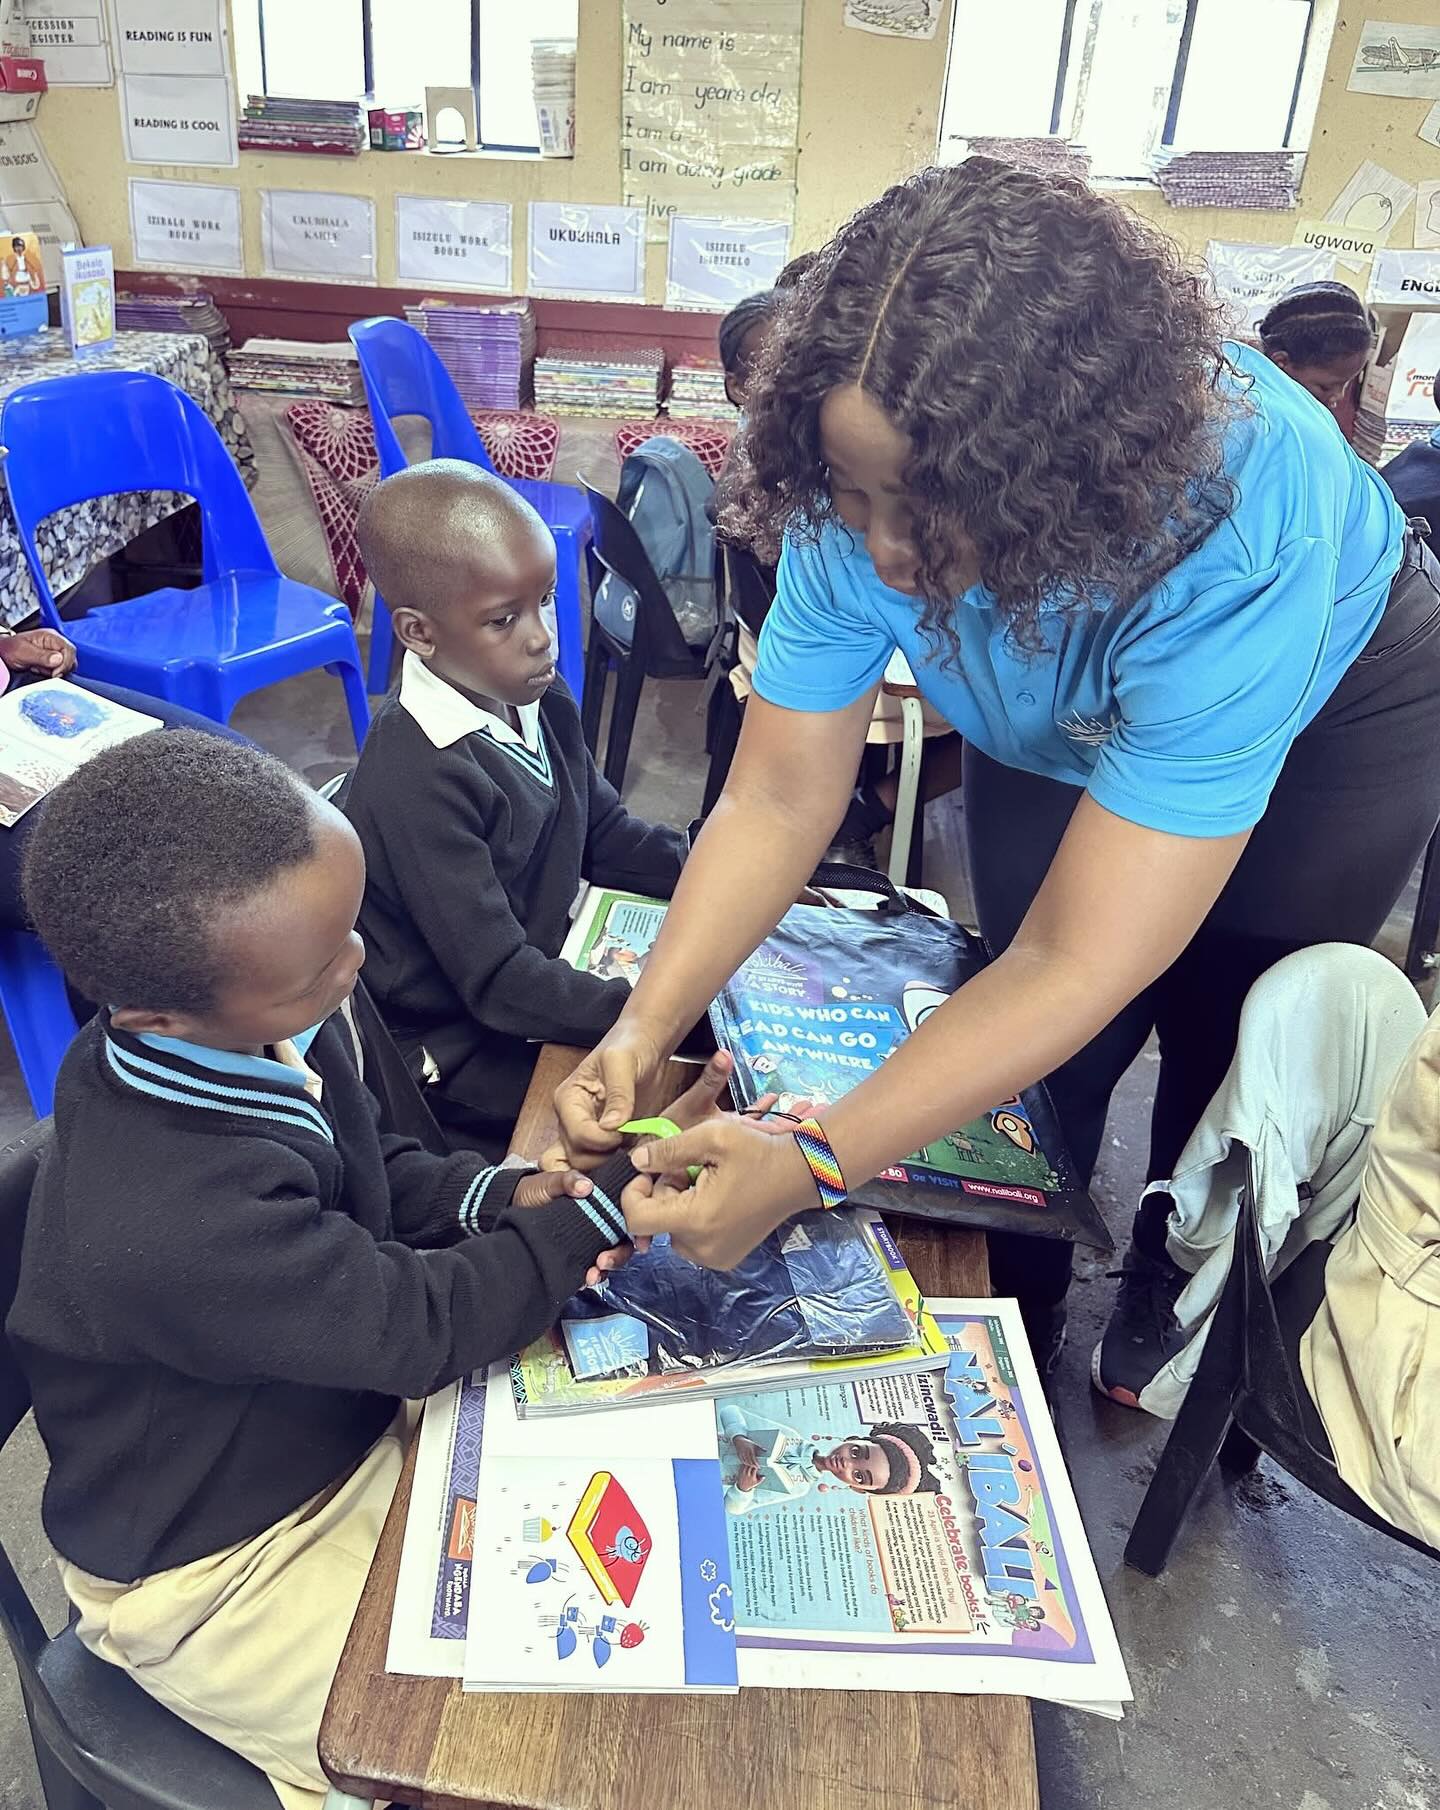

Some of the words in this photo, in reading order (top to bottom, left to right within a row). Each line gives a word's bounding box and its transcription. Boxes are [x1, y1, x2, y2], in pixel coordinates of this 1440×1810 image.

[26, 20, 74, 30] CESSION
[30, 34, 74, 44] EGISTER
[125, 30, 175, 41] READING
[178, 32, 186, 42] IS
[190, 32, 212, 42] FUN
[629, 23, 652, 57] My
[663, 35, 712, 50] name
[719, 32, 735, 51] is
[624, 65, 637, 92] I
[640, 80, 671, 95] am
[695, 86, 745, 109] years
[750, 82, 781, 104] old
[134, 118, 177, 129] READING
[181, 120, 189, 130] IS
[192, 121, 220, 131] COOL
[623, 116, 634, 138] I
[637, 127, 662, 140] am
[670, 129, 682, 142] a
[623, 149, 632, 170] I
[639, 160, 668, 174] am
[733, 165, 782, 187] grade
[646, 195, 678, 217] live
[193, 220, 221, 231] WORK
[413, 231, 451, 243] ISIZULU
[460, 235, 489, 247] WORK
[550, 228, 620, 245] UKUBHALA
[706, 241, 746, 253] ISIZULU
[1303, 231, 1374, 254] ugwava
[434, 246, 467, 257] BOOKS
[1401, 279, 1440, 293] ENGL
[749, 1000, 795, 1017] KIDS
[795, 1007, 848, 1023] WHO
[850, 1007, 891, 1023] CAN
[728, 1019, 788, 1038] READ
[791, 1027, 834, 1045] CAN
[839, 1032, 877, 1048] GO
[889, 1168, 902, 1178] 80
[928, 1175, 960, 1188] VISIT
[967, 1183, 1039, 1204] www.nalibali.org
[877, 1227, 898, 1260] STORYBOOK
[915, 1373, 950, 1441] izincwadi!
[849, 1508, 859, 1535] children
[860, 1508, 868, 1526] What
[901, 1502, 912, 1529] throughout
[927, 1510, 934, 1518] 23
[927, 1519, 939, 1535] April
[853, 1537, 861, 1553] like?
[862, 1529, 871, 1547] kinds
[885, 1529, 893, 1554] motivates
[865, 1549, 872, 1557] of
[915, 1503, 924, 1523] Reading
[939, 1596, 948, 1617] children
[935, 1544, 947, 1565] World
[936, 1495, 969, 1571] Celebrate
[959, 1575, 986, 1619] books!
[867, 1559, 876, 1582] books
[904, 1553, 912, 1574] children
[908, 1575, 917, 1595] reading
[942, 1567, 953, 1585] Book
[870, 1584, 877, 1594] do
[902, 1578, 912, 1608] understand
[923, 1559, 931, 1579] children
[932, 1602, 942, 1623] reading
[945, 1587, 958, 1604] Day!
